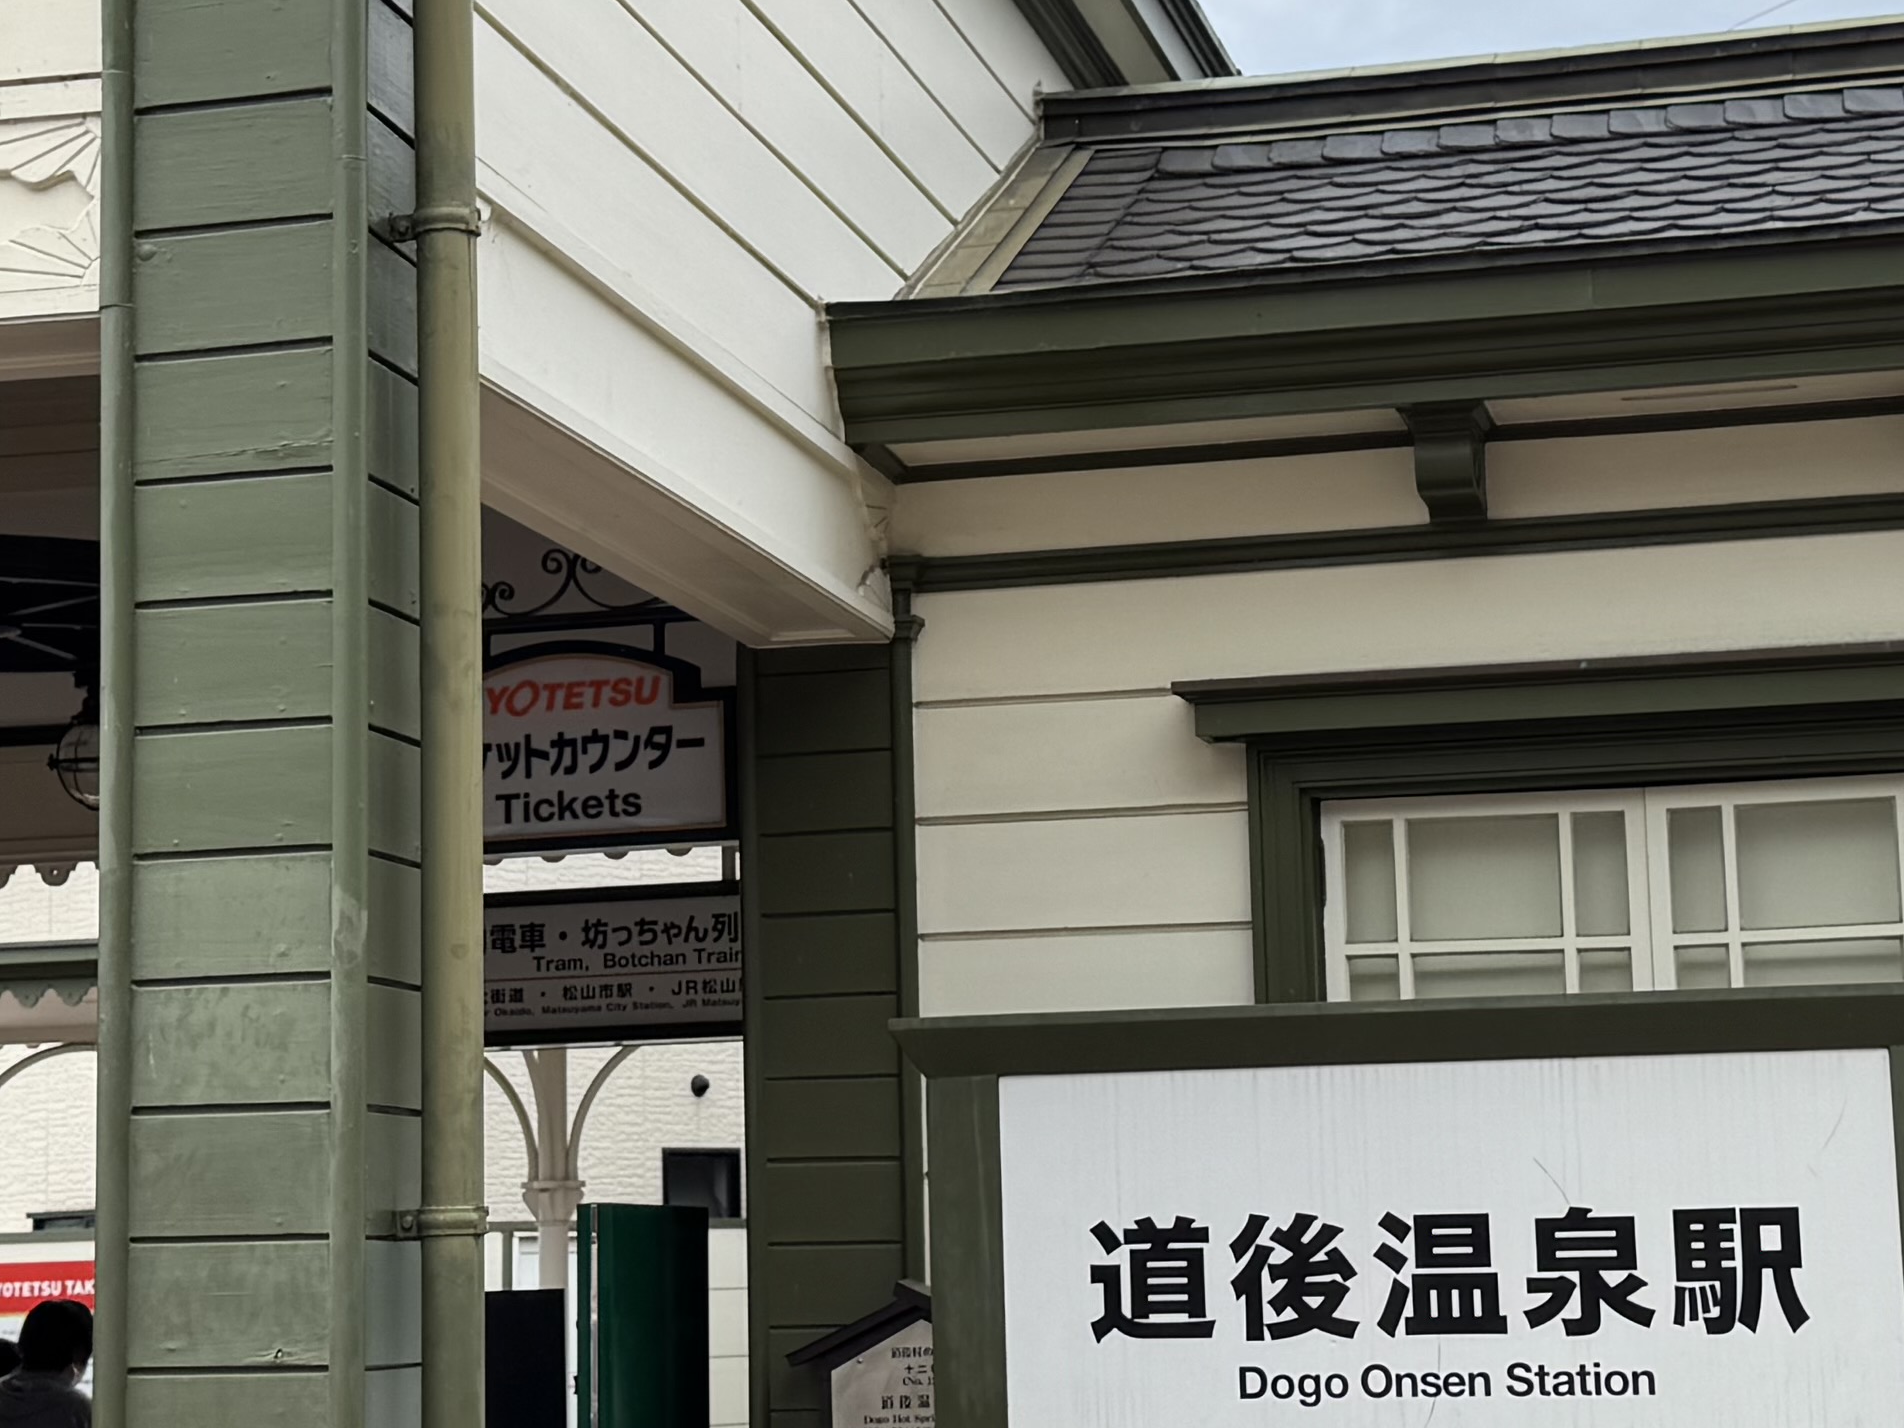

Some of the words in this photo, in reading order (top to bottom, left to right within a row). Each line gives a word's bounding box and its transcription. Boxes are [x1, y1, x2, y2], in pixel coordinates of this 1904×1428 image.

[485, 675, 661, 717] YOTETSU
[495, 788, 642, 824] Tickets
[484, 911, 739, 955] 電車・坊っちゃん列
[533, 955, 589, 973] Tram,
[603, 950, 687, 970] Botchan
[671, 976, 743, 997] JR松山
[542, 1004, 602, 1015] Matsuyama
[606, 1002, 628, 1013] City
[682, 999, 697, 1008] JR
[1089, 1206, 1811, 1344] 道後温泉駅
[1238, 1365, 1349, 1407] Dogo
[1360, 1363, 1492, 1399] Onsen
[1505, 1361, 1657, 1398] Station
